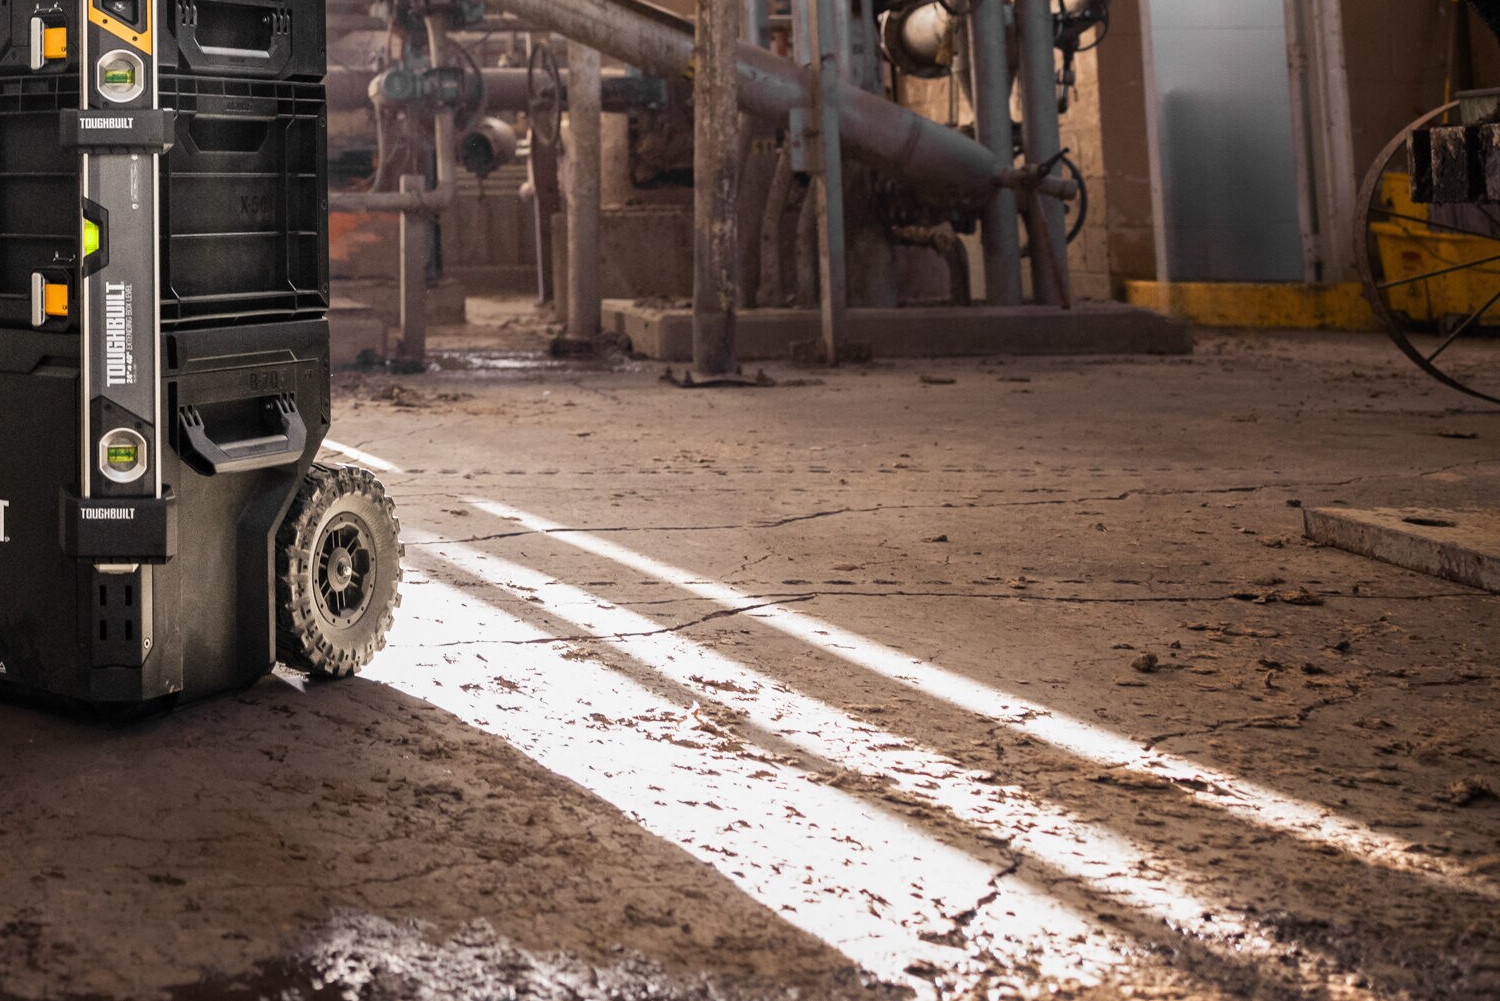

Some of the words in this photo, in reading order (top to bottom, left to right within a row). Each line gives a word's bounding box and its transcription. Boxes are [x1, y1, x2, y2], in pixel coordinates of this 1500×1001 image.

[80, 117, 134, 129] TOUGHBUILT
[125, 283, 133, 301] LEVEL
[106, 281, 125, 388] TOUGHBUILT
[80, 507, 135, 520] TOUGHBUILT
